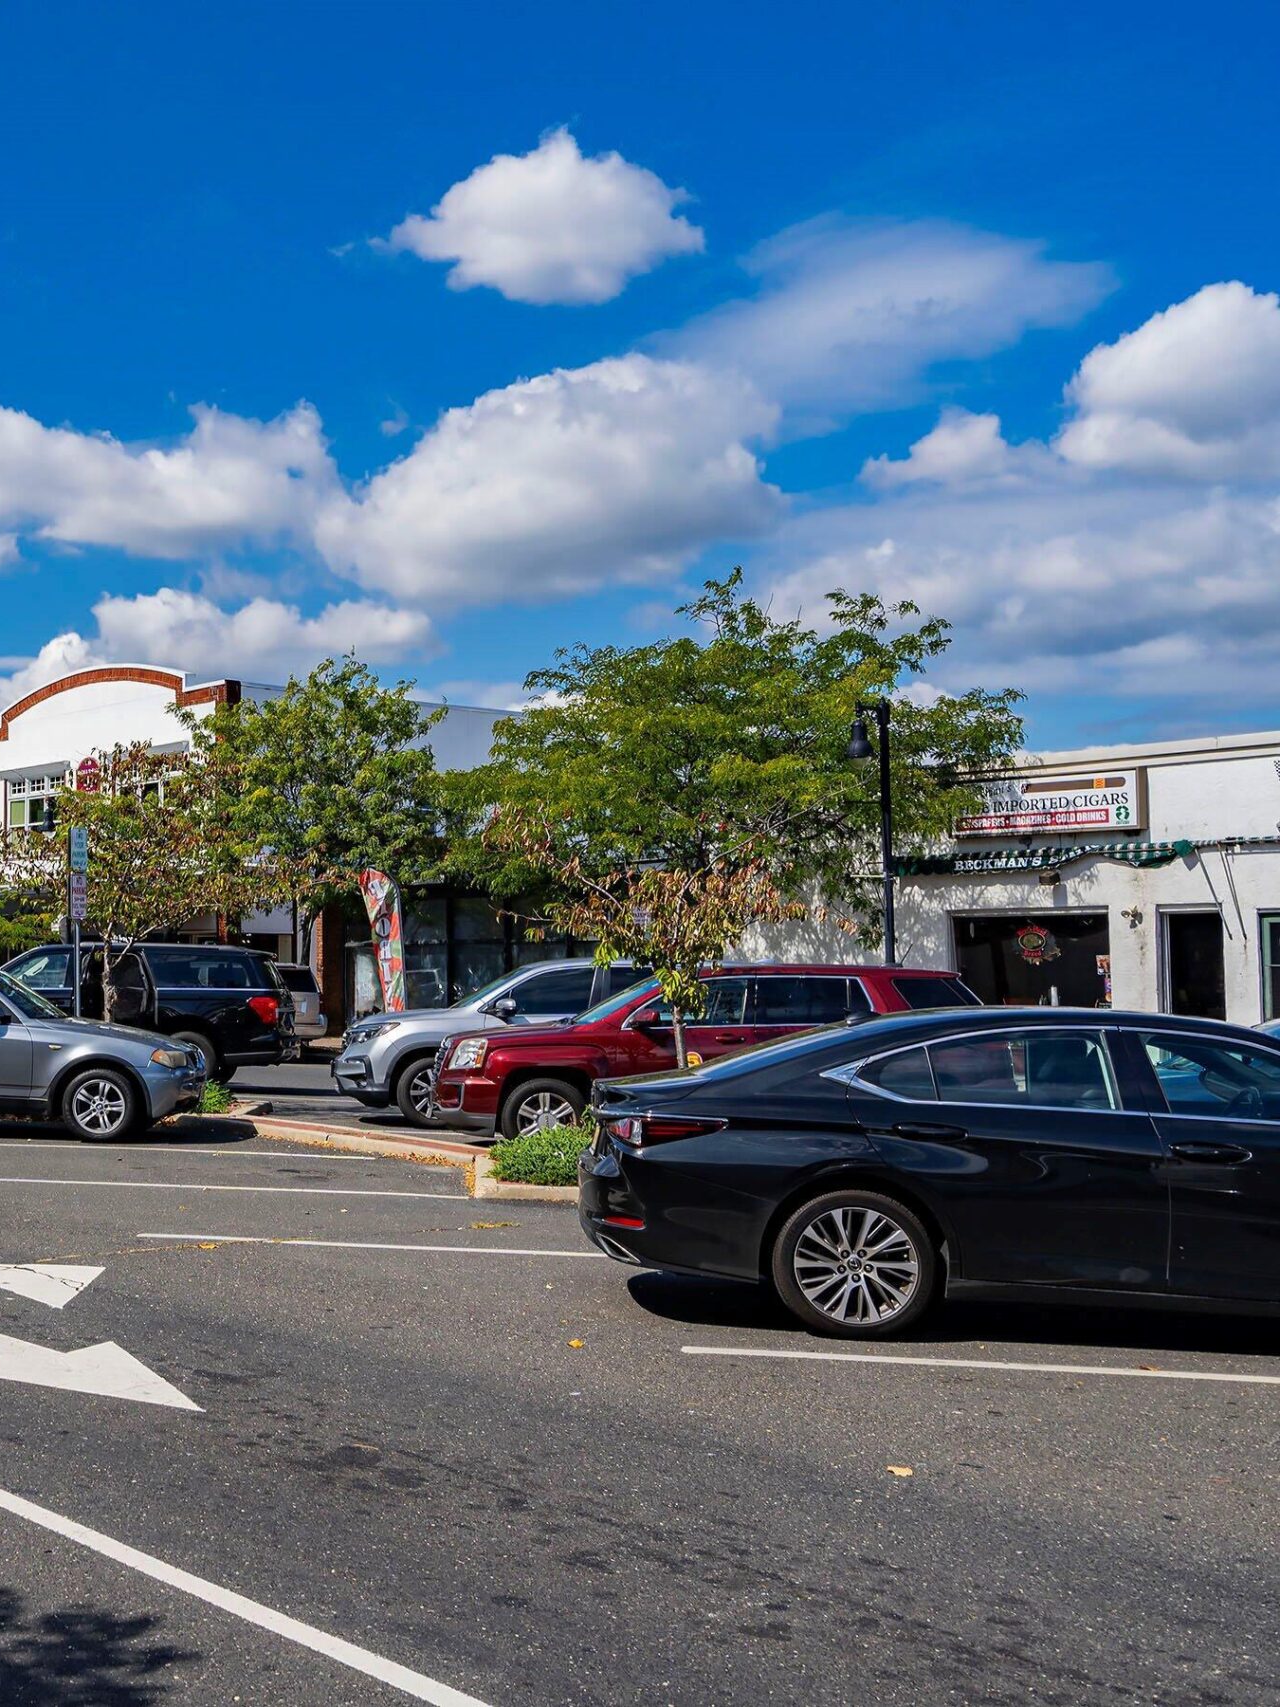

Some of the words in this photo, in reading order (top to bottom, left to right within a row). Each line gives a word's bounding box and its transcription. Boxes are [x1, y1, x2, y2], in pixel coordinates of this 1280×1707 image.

[993, 796, 1070, 813] IMPORTED
[1072, 792, 1129, 808] CIGARS
[1009, 813, 1052, 827] MAGAZINES
[1055, 810, 1076, 824] COLD
[1077, 808, 1107, 822] DRINKS
[954, 856, 1043, 872] BECKMAN'S
